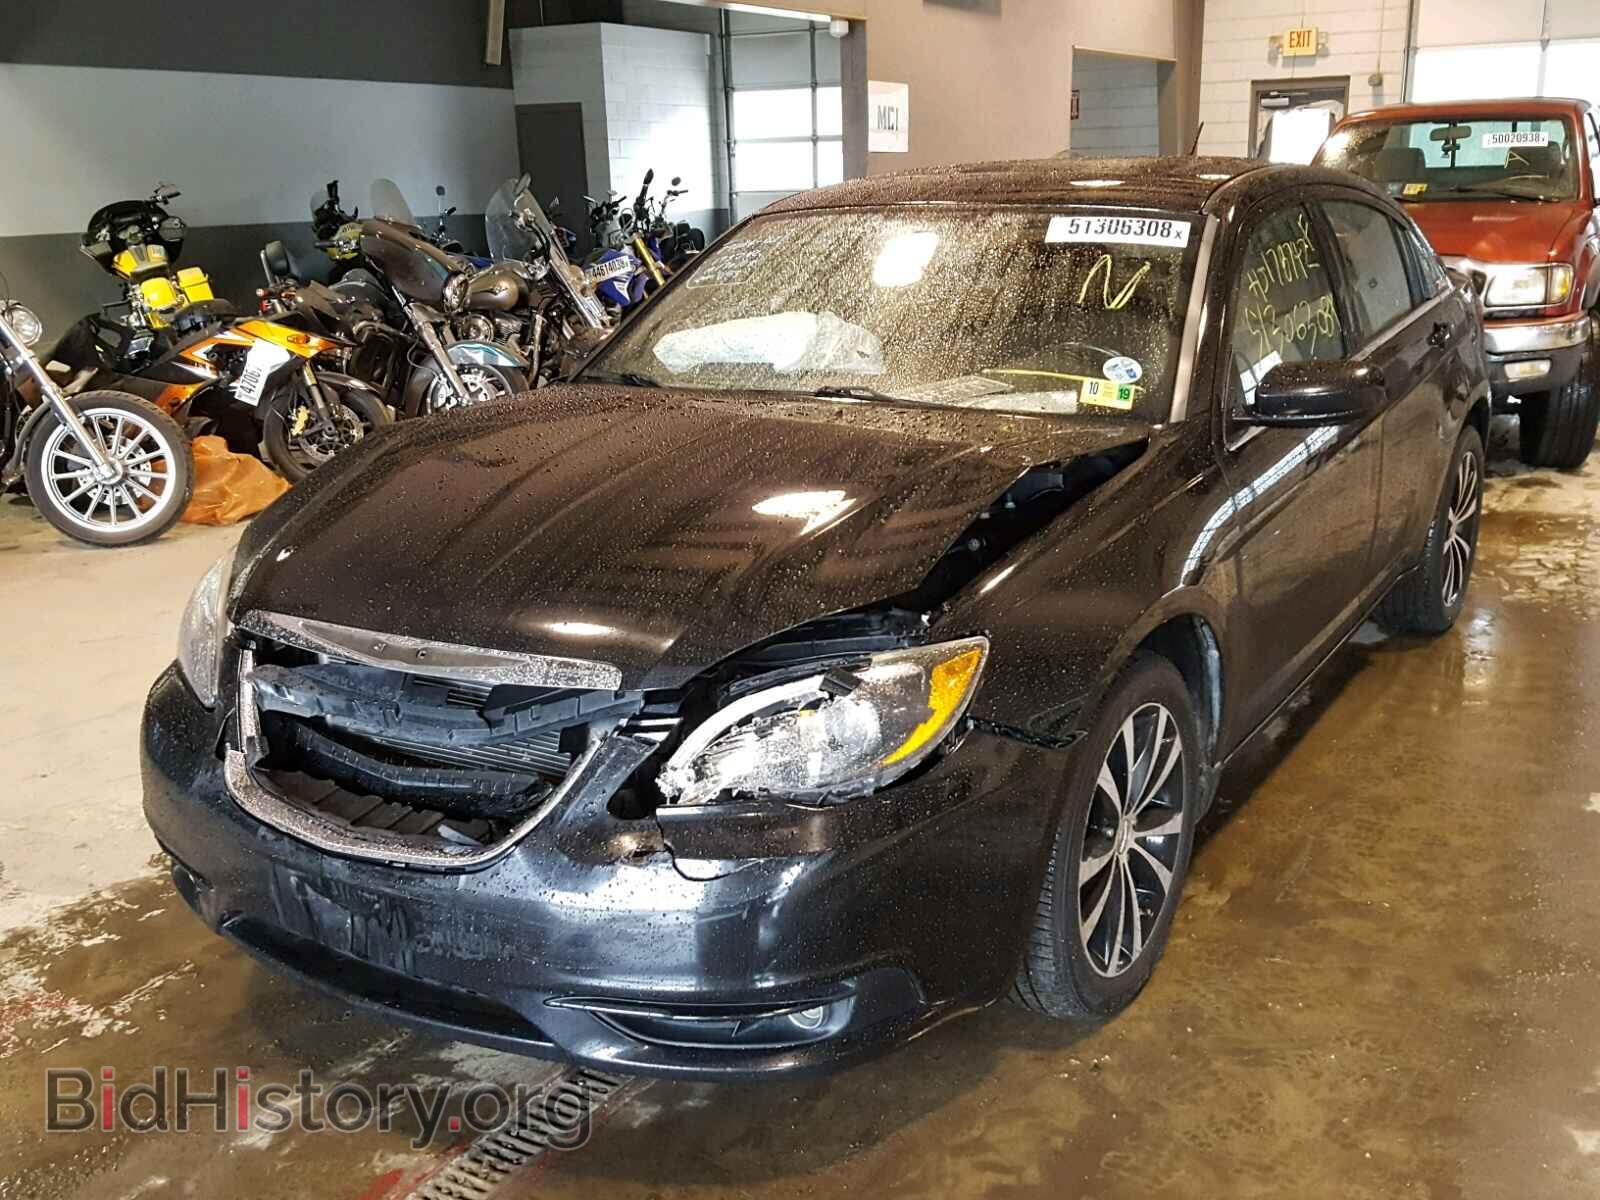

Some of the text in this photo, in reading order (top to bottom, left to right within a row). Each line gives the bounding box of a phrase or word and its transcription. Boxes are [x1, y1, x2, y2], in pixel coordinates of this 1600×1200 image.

[1289, 30, 1312, 48] EXIT
[1089, 381, 1131, 400] 10 19
